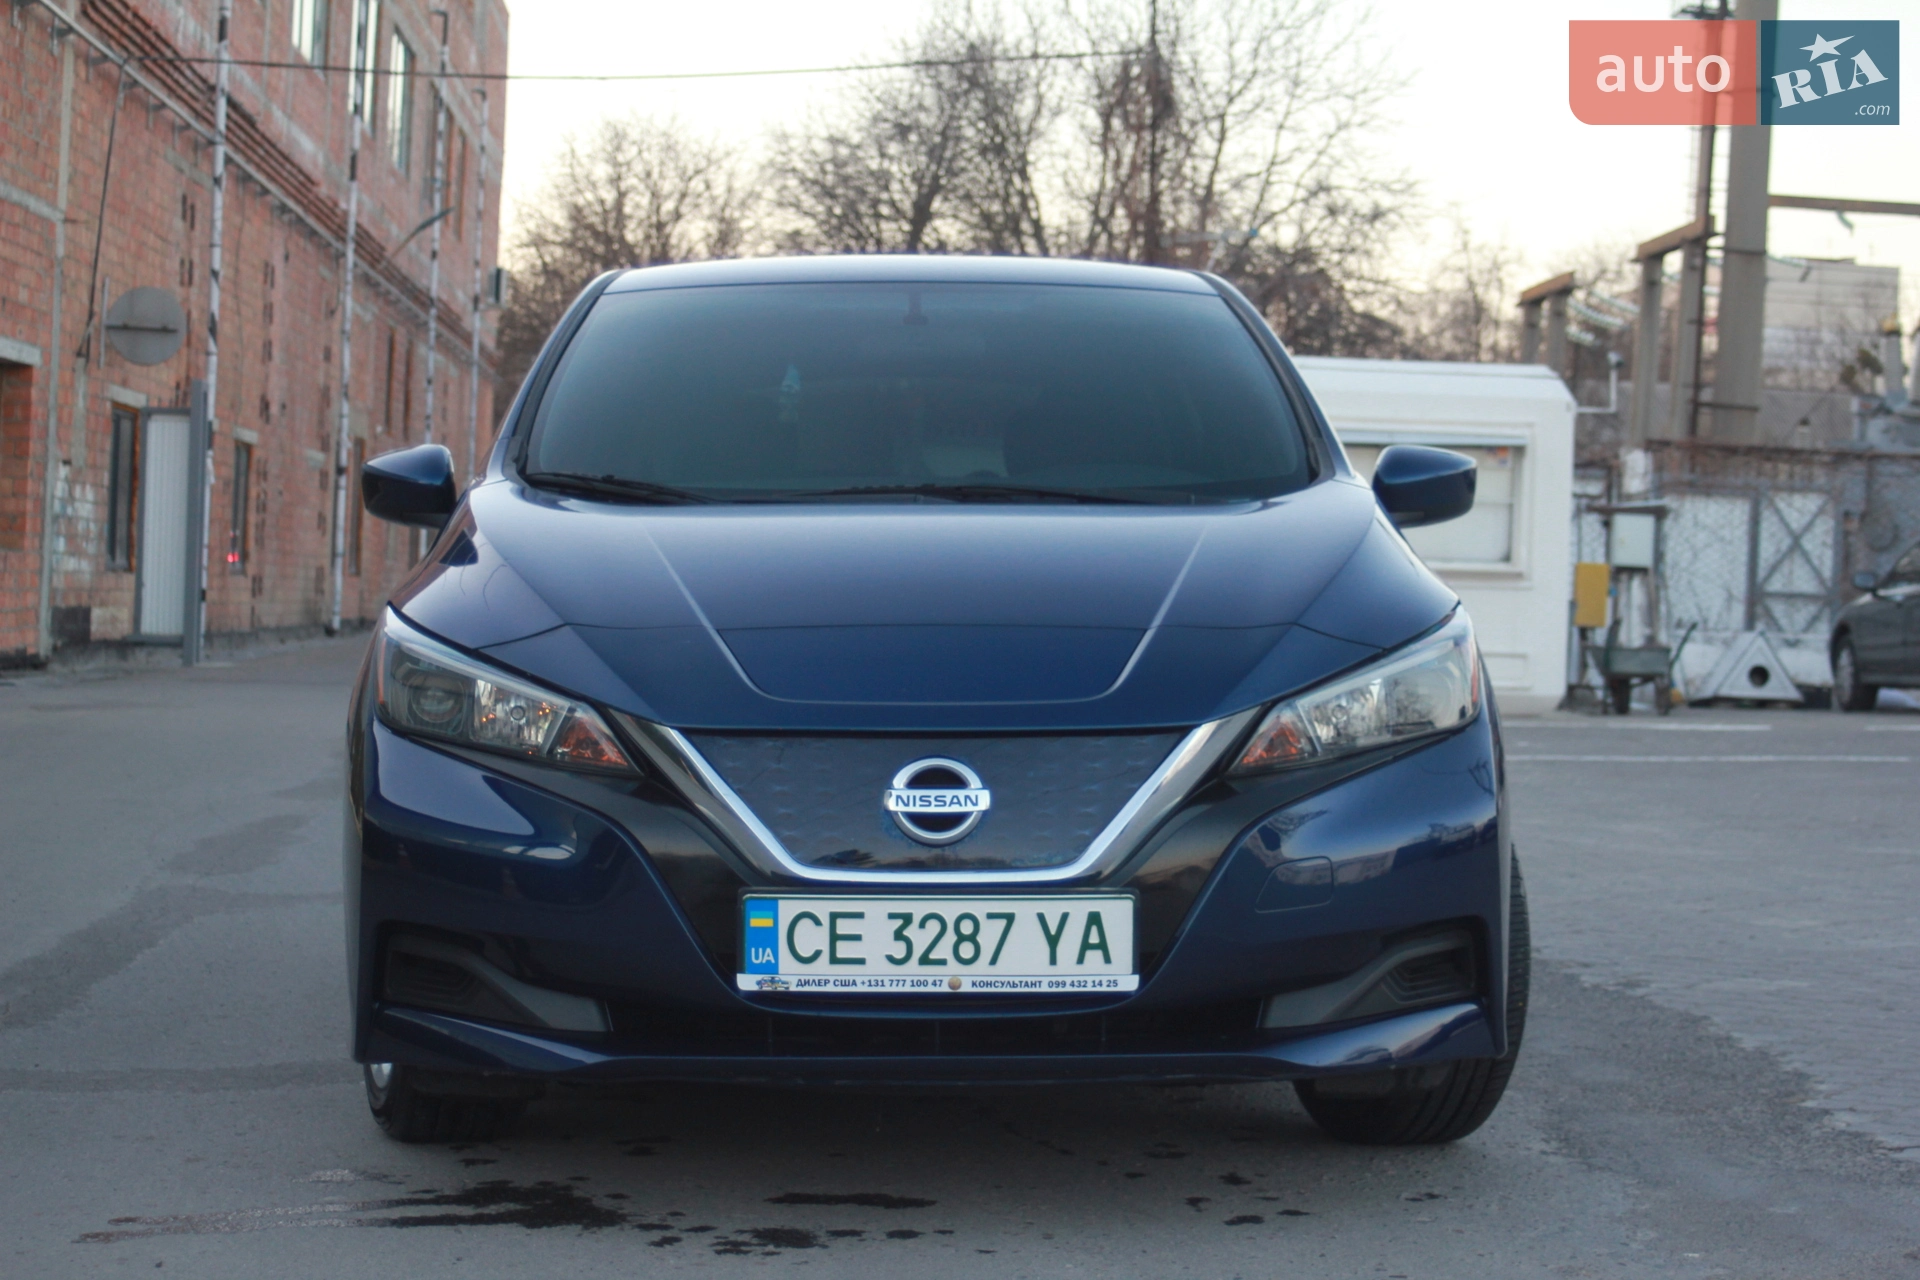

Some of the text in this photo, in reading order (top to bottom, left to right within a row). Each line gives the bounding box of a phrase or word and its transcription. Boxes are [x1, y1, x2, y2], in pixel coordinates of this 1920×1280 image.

[896, 795, 978, 807] NISSAN
[786, 911, 1112, 966] CE 3287 YA
[751, 947, 775, 964] UA
[796, 979, 943, 988] ДИЛЕР США +131 777 100 47
[971, 979, 1118, 988] КОНСУЛЬТАНТ 099 432 14 25
